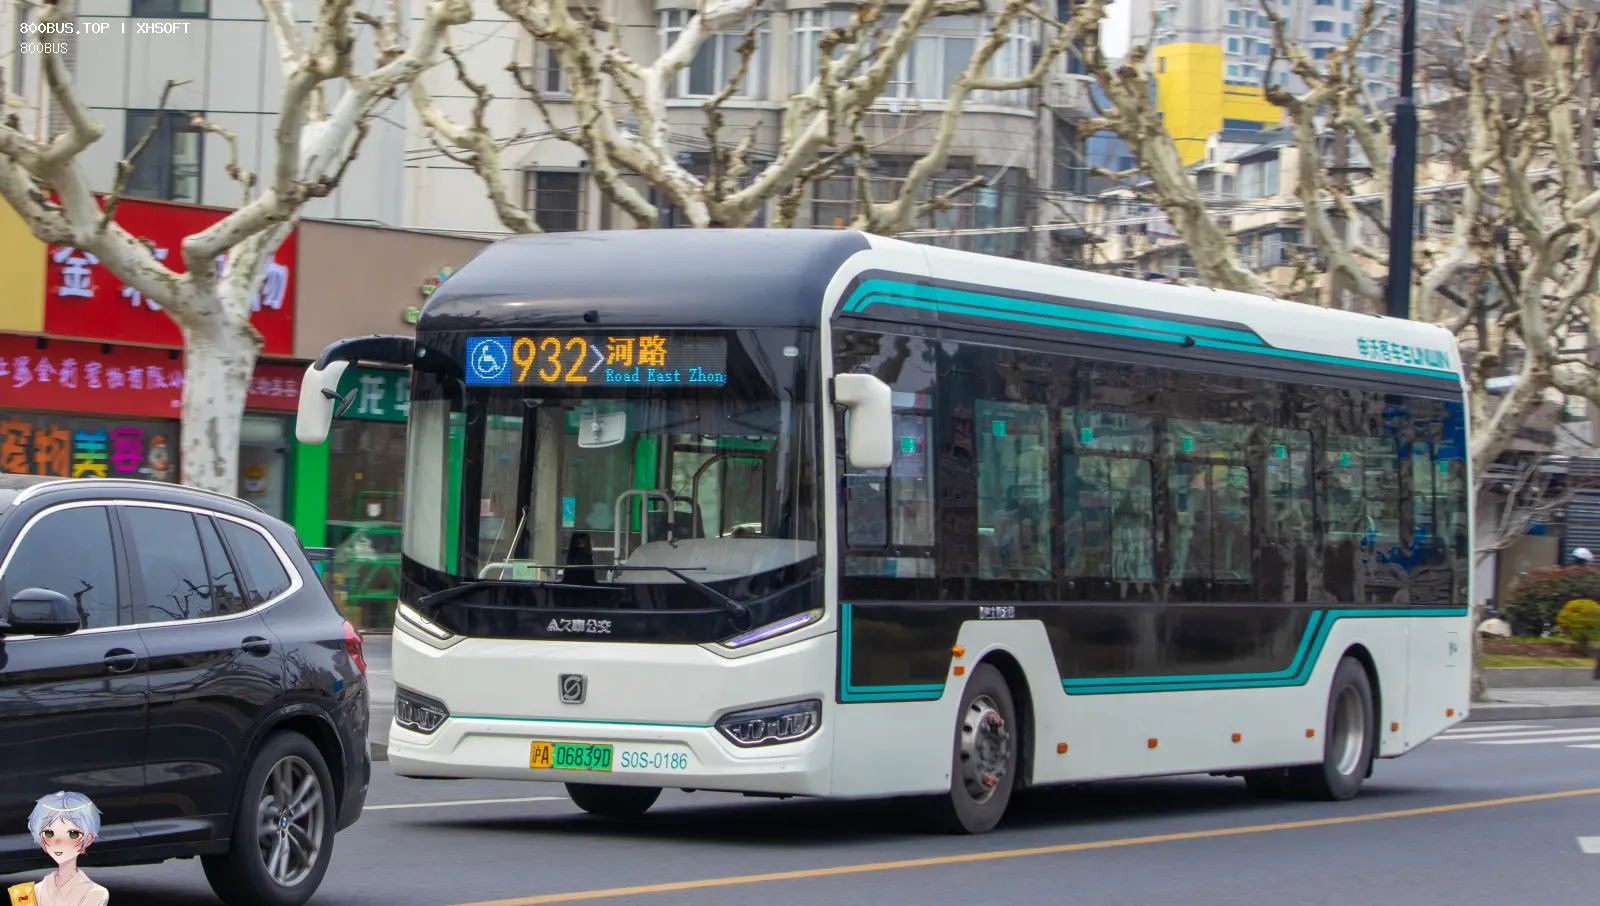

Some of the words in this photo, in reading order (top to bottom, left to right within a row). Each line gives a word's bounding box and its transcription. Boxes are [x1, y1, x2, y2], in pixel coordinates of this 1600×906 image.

[512, 336, 588, 382] 932
[606, 335, 667, 367] 河路
[606, 368, 640, 382] Road
[646, 368, 681, 382] East
[0, 415, 145, 478] 宠物美容
[556, 746, 611, 768] 06839D
